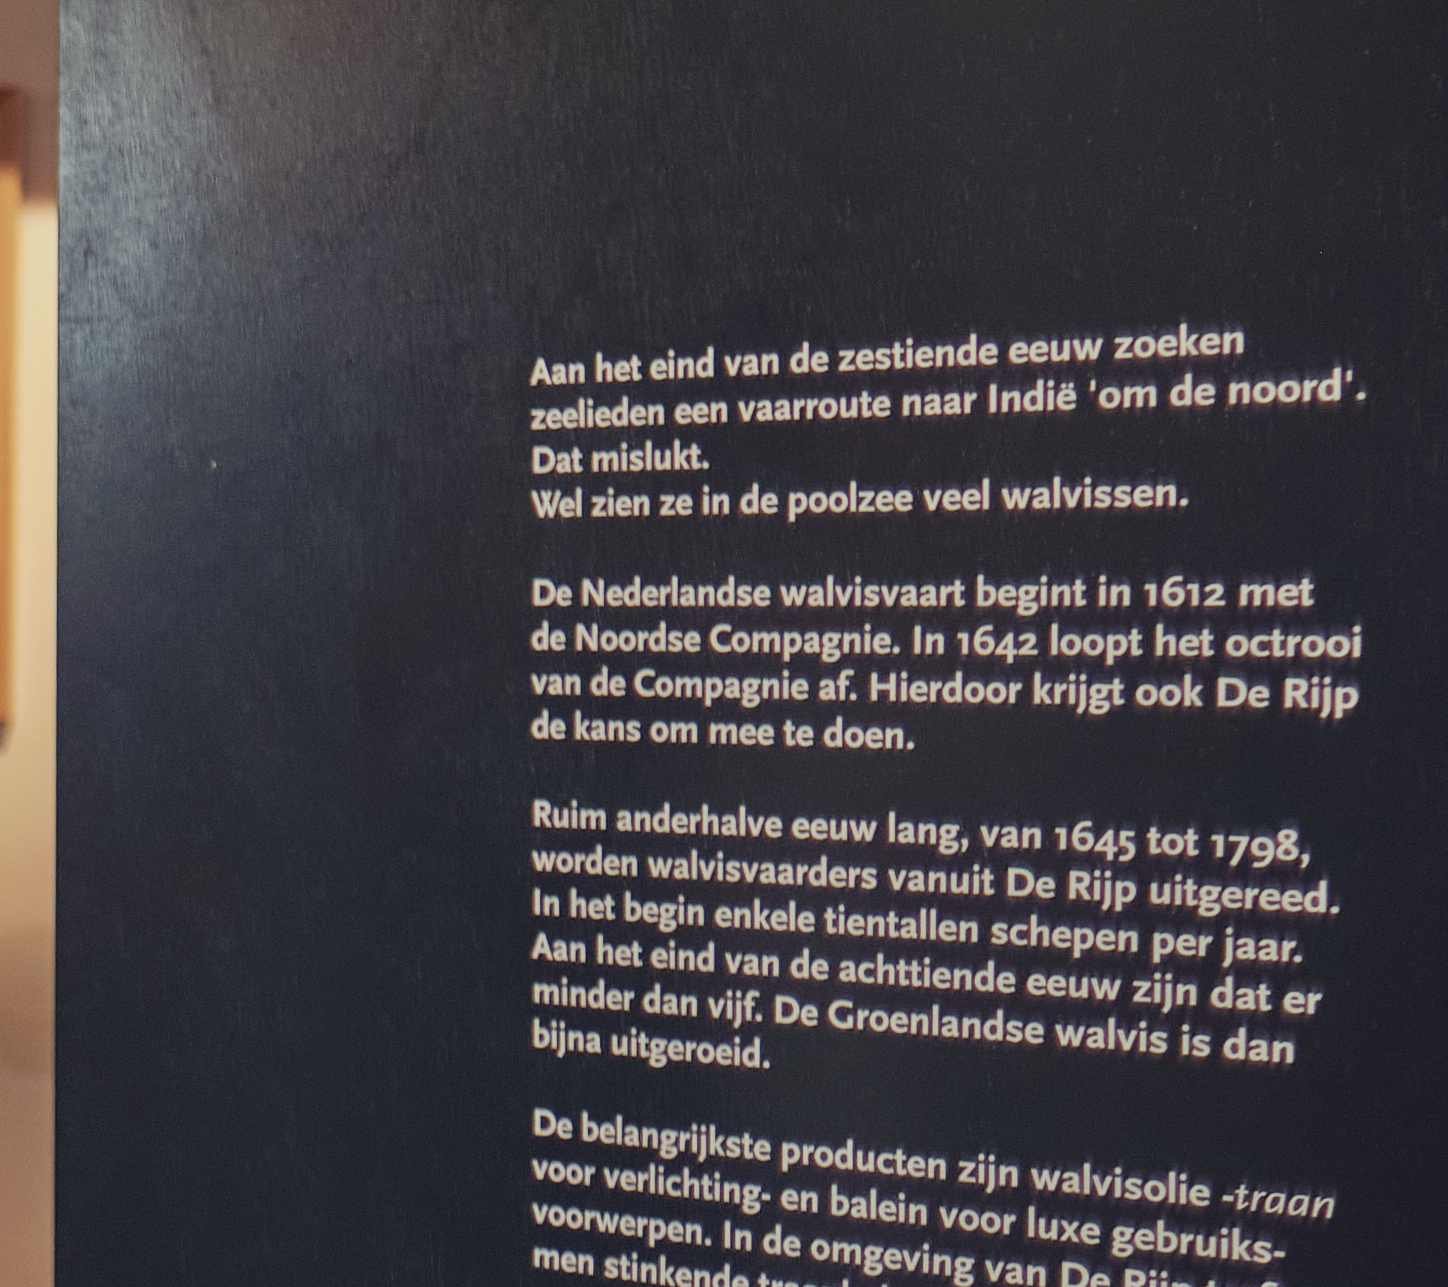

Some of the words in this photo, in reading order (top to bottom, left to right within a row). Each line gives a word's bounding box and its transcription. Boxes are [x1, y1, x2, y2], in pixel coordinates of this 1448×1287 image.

[530, 357, 585, 386] Aan
[595, 352, 642, 382] het
[650, 346, 714, 380] eind
[724, 353, 779, 376] van
[790, 341, 829, 374] de
[838, 333, 998, 372] zestiende
[1008, 337, 1103, 364] eeuw
[1114, 323, 1244, 359] zoeken
[531, 395, 664, 430] zeelieden
[674, 401, 728, 424] een
[738, 391, 891, 422] vaarroute
[902, 392, 977, 416] naar
[989, 379, 1077, 413] Indië
[1169, 372, 1216, 407] de
[532, 446, 583, 474] Dat
[592, 439, 709, 472] mislukt.
[531, 487, 582, 518] Wel
[591, 487, 650, 517] zien
[659, 494, 693, 516] ze
[702, 485, 730, 515] in
[740, 482, 778, 515] de
[788, 480, 913, 523] poolzee
[923, 477, 990, 511] veel
[1001, 475, 1189, 510] walvissen.
[532, 578, 572, 607] De
[581, 575, 771, 607] Nederlandse
[780, 574, 965, 607] walvisvaart
[976, 574, 1087, 616] begint
[1098, 574, 1131, 607] in
[1144, 575, 1226, 607] 1612
[1239, 577, 1314, 607] met
[531, 620, 566, 651] de
[575, 621, 701, 653] Noordse
[709, 623, 900, 663] Compagnie.
[913, 625, 944, 655] In
[957, 624, 1038, 664] 1642
[1050, 623, 1143, 666] loopt
[1155, 623, 1214, 657] het
[1225, 624, 1362, 658] octrooi
[531, 674, 581, 695] van
[590, 665, 626, 697] de
[634, 668, 809, 708] Compagnie
[819, 669, 857, 701] af.
[870, 671, 1022, 704] Hierdoor
[1033, 671, 1125, 715] krijgt
[1135, 673, 1203, 707] ook
[1217, 676, 1270, 708] De
[1284, 676, 1359, 719] Rijp
[530, 709, 566, 740] de
[574, 710, 641, 742] kans
[650, 721, 698, 743] om
[709, 722, 774, 746] mee
[783, 720, 814, 747] te
[823, 716, 915, 750] doen.
[533, 799, 606, 830] Ruim
[616, 802, 783, 838] anderhalve
[791, 817, 877, 842] eeuw
[888, 811, 969, 855] lang,
[980, 825, 1042, 849] van
[1055, 820, 1136, 862] 1645
[1146, 826, 1199, 856] tot
[1211, 828, 1310, 869] 1798,
[532, 844, 638, 876] worden
[647, 849, 877, 890] walvisvaarders
[888, 863, 995, 896] vanuit
[1007, 867, 1055, 899] De
[1068, 869, 1137, 912] Rijp
[1150, 874, 1340, 917] uitgereed.
[533, 887, 559, 916] In
[570, 887, 615, 920] het
[624, 890, 704, 933] begin
[714, 898, 815, 933] enkele
[824, 904, 978, 943] tientallen
[991, 914, 1138, 958] schepen
[1152, 932, 1213, 963] per
[1222, 926, 1302, 968] jaar.
[531, 932, 586, 963] Aan
[596, 933, 643, 967] het
[650, 940, 715, 972] eind
[725, 952, 779, 977] van
[790, 948, 829, 980] de
[839, 952, 1016, 994] achttiende
[1026, 973, 1122, 1001] eeuw
[1133, 972, 1197, 1013] zijn
[1210, 975, 1272, 1012] dat
[1283, 991, 1323, 1015] er
[532, 1017, 601, 1058] bijna
[611, 1027, 770, 1069] uitgeroeid.
[533, 977, 635, 1011] minder
[642, 983, 697, 1017] dan
[708, 989, 762, 1029] vijf.
[775, 995, 818, 1027] De
[828, 999, 1044, 1044] Groenlandse
[1055, 1017, 1168, 1054] walvis
[1181, 1024, 1211, 1058] is
[1223, 1027, 1295, 1064] dan
[533, 1108, 573, 1139] De
[581, 1110, 771, 1162] belangrijkste
[781, 1138, 946, 1180] producten
[958, 1153, 1019, 1194] zijn
[1031, 1162, 1211, 1207] walvisolie
[532, 1159, 596, 1186] voor
[603, 1163, 771, 1215] verlichting-
[780, 1189, 818, 1213] en
[831, 1184, 927, 1225] balein
[939, 1206, 1016, 1235] voor
[1027, 1205, 1101, 1245] luxe
[1111, 1219, 1286, 1264] gebruiks-
[532, 1203, 712, 1248] voorwerpen.
[724, 1220, 752, 1251] In
[762, 1224, 801, 1257] de
[810, 1239, 975, 1287] omgeving
[985, 1260, 1046, 1287] van
[533, 1247, 594, 1275] men
